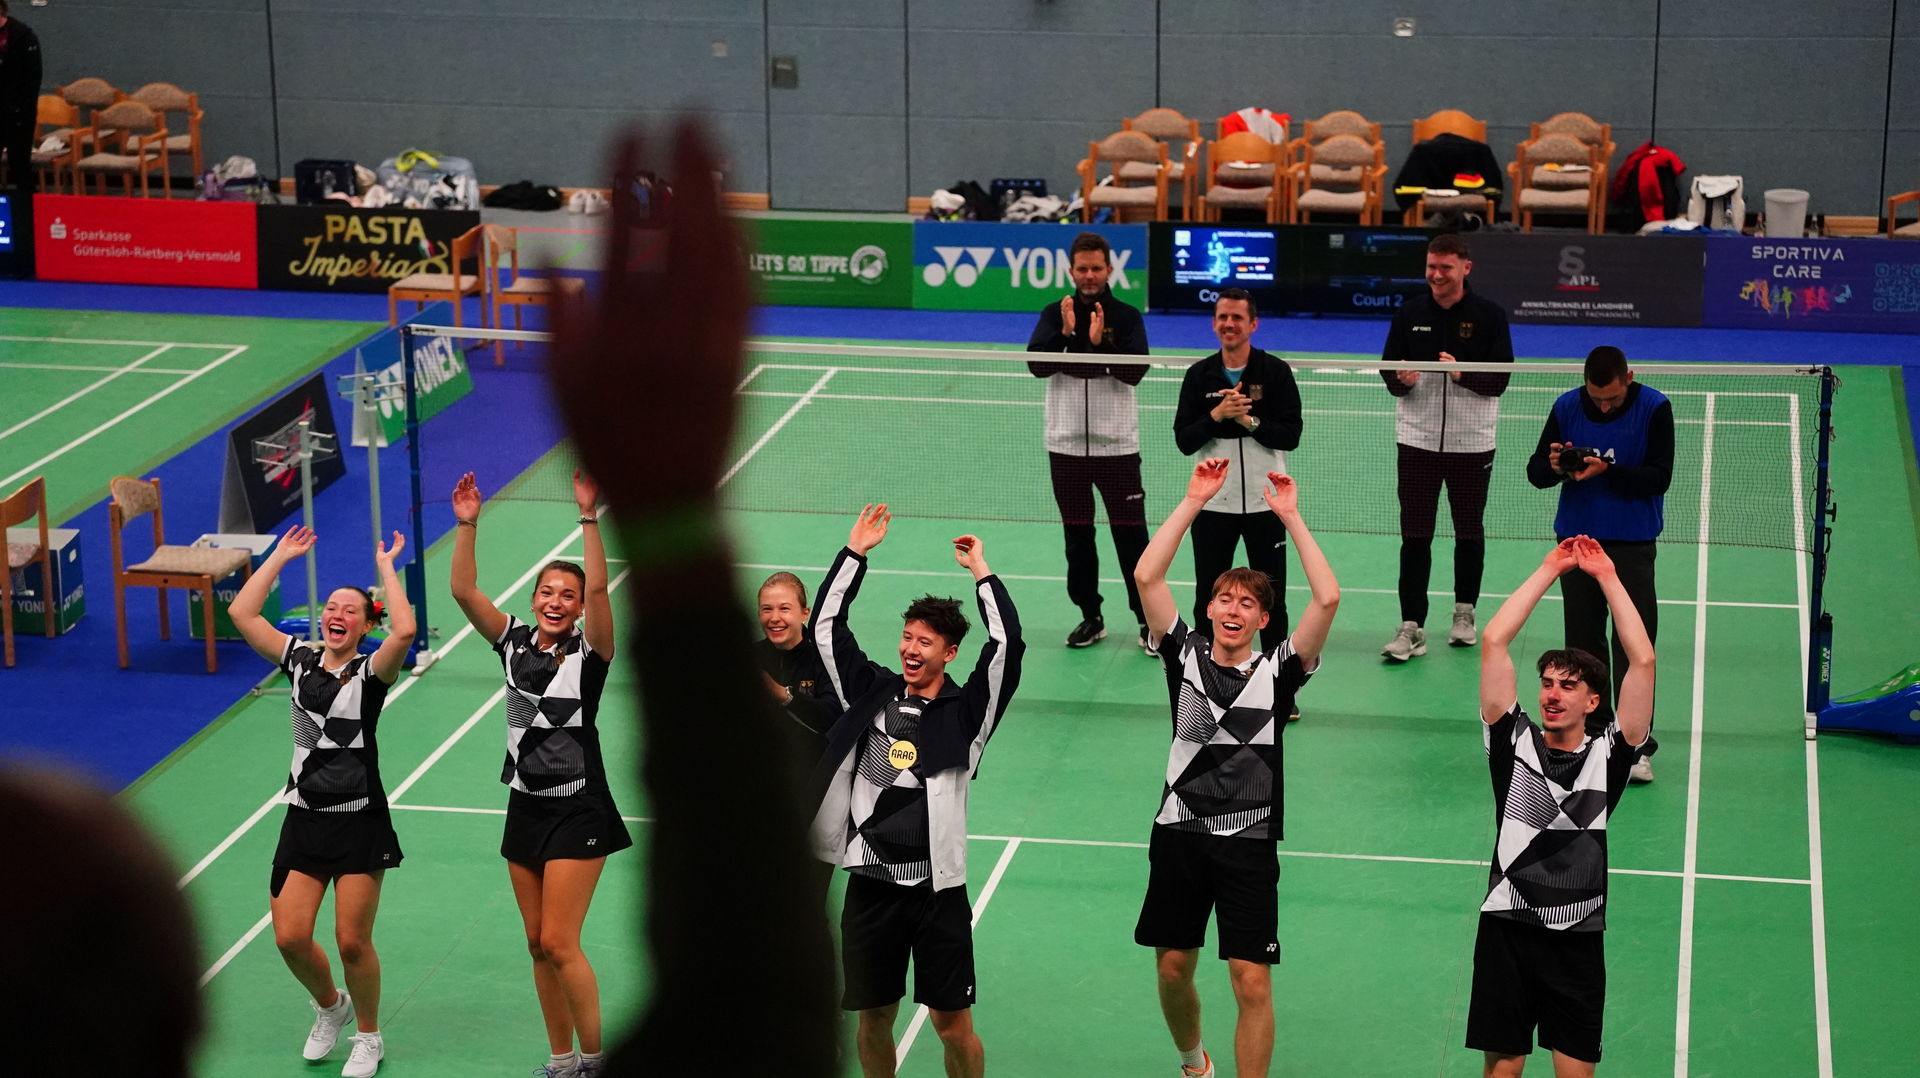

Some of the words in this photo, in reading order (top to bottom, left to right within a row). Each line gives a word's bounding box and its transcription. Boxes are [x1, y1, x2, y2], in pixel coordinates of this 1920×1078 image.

[72, 228, 132, 242] Sparkasse
[325, 215, 426, 245] PASTA
[73, 244, 241, 263] Gütersloh-Rietberg-Versmold
[1752, 246, 1845, 261] SPORTIVA
[1003, 247, 1132, 290] YONX
[1773, 265, 1821, 279] CARE
[1568, 275, 1600, 286] APL
[1352, 292, 1391, 307] Court
[1394, 294, 1404, 307] 2
[17, 600, 57, 614] YONX
[891, 748, 915, 761] ARAG
